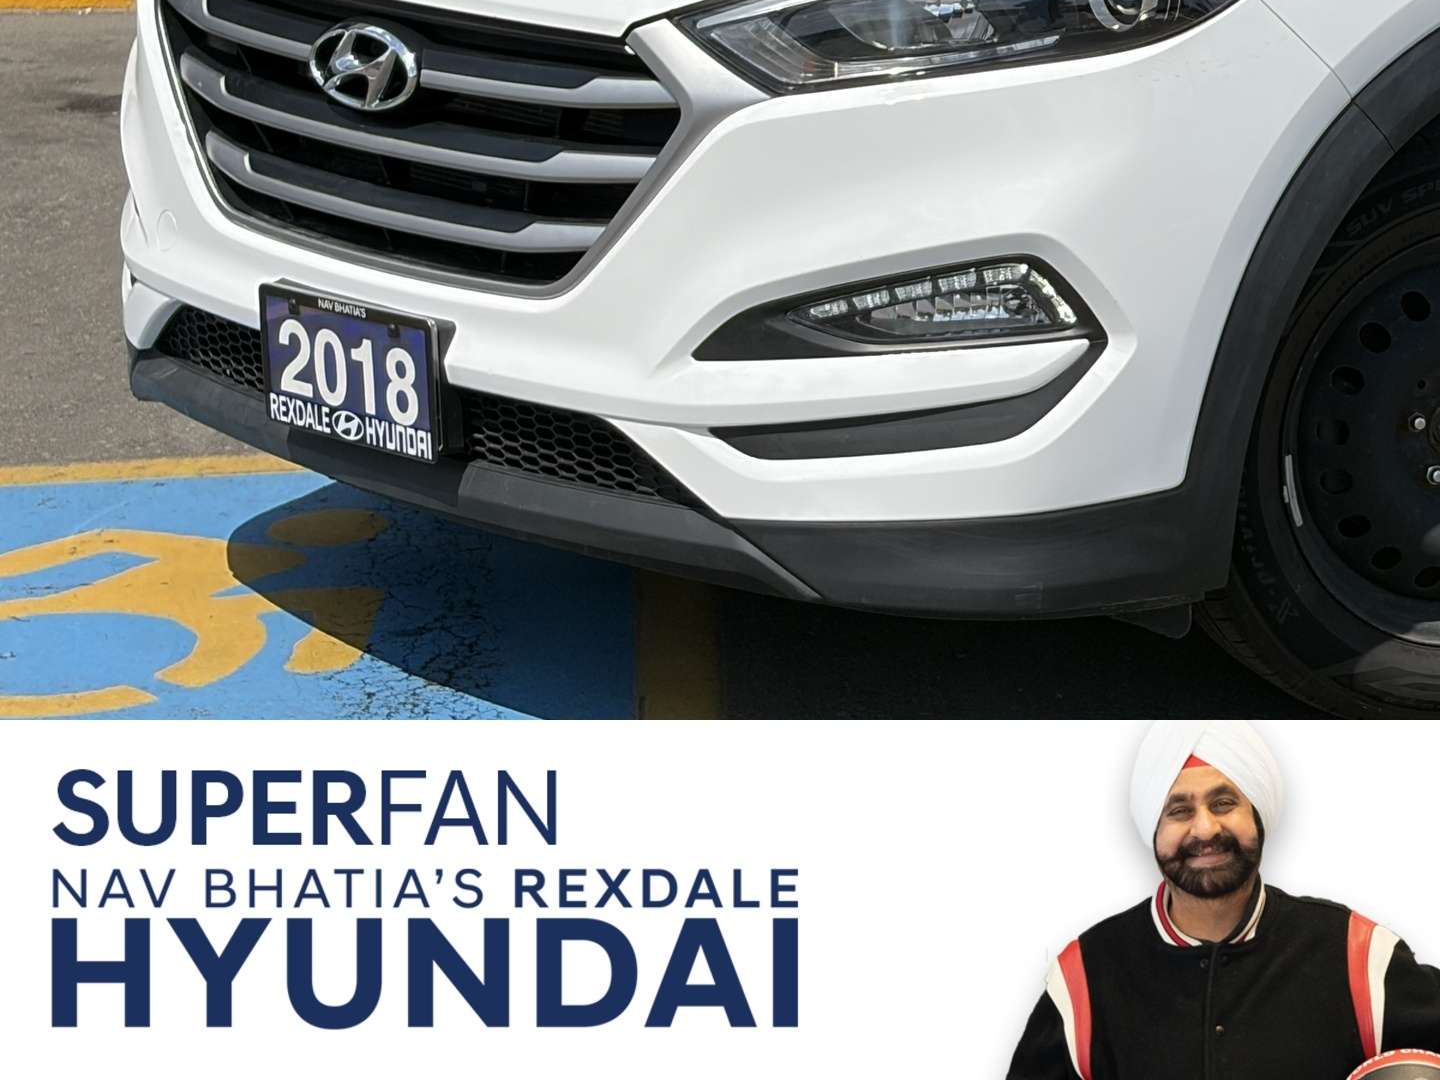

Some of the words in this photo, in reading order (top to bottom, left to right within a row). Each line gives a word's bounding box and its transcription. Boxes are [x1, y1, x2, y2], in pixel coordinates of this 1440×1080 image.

[318, 298, 333, 311] NAV
[334, 302, 367, 319] BHATIA'S
[278, 319, 419, 426] 2018
[270, 393, 331, 433] REXDALE
[366, 417, 433, 460] HYUNDAI
